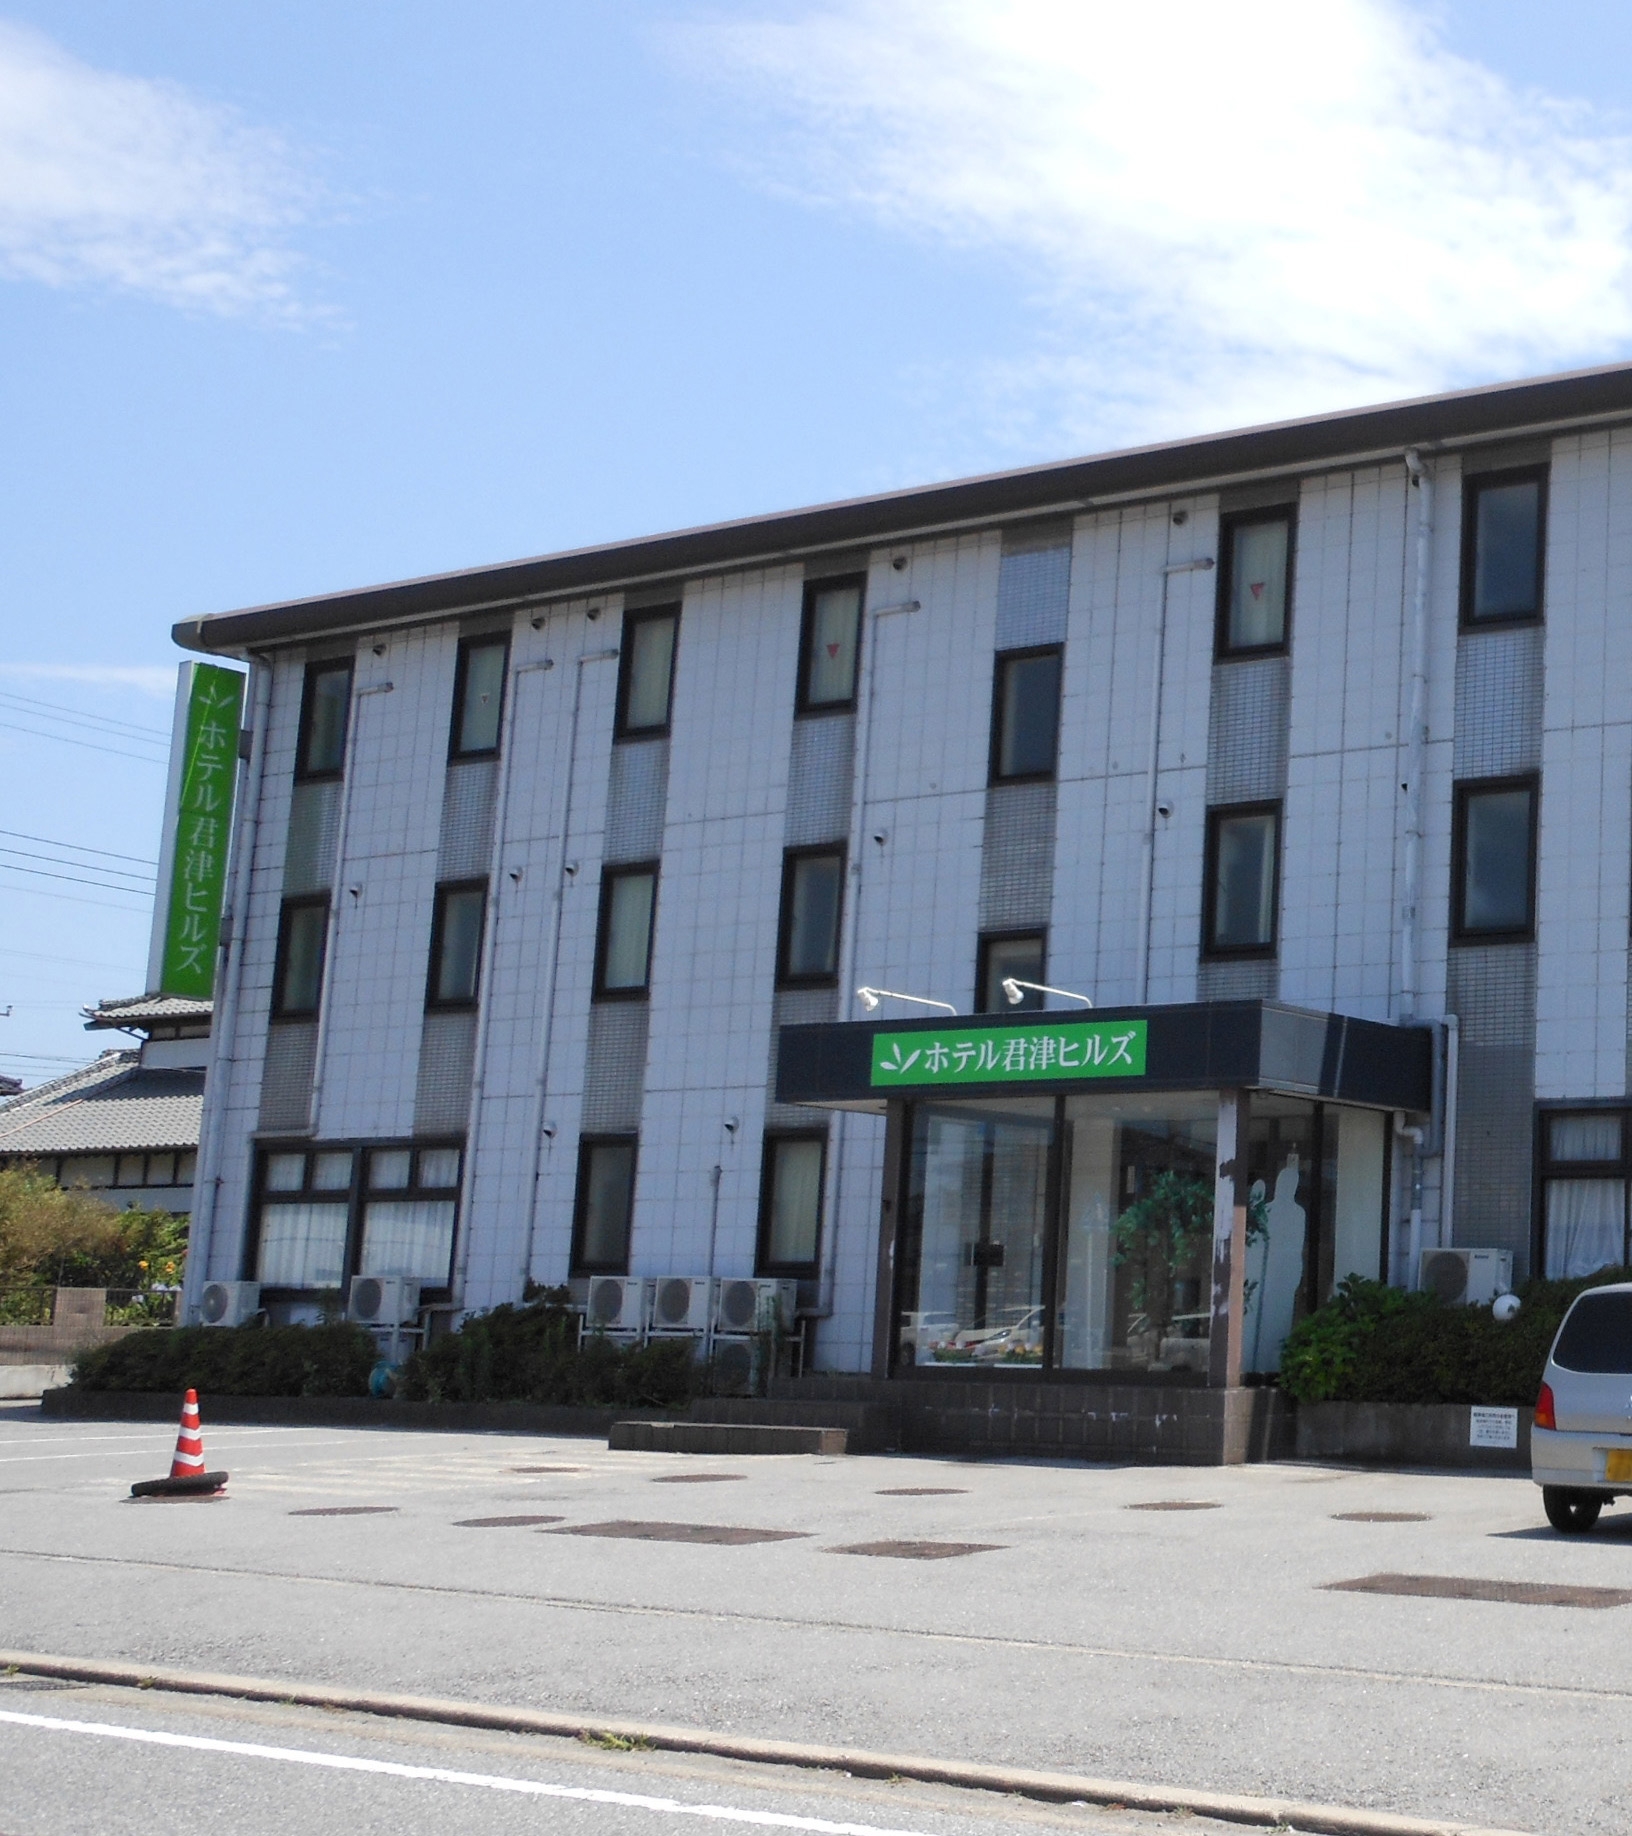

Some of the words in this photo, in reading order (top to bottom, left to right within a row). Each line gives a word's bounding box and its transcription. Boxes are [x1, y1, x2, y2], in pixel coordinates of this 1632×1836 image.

[177, 721, 227, 974] ホテル君津ヒルズ
[924, 1031, 1136, 1074] ホテル君津ヒルズ
